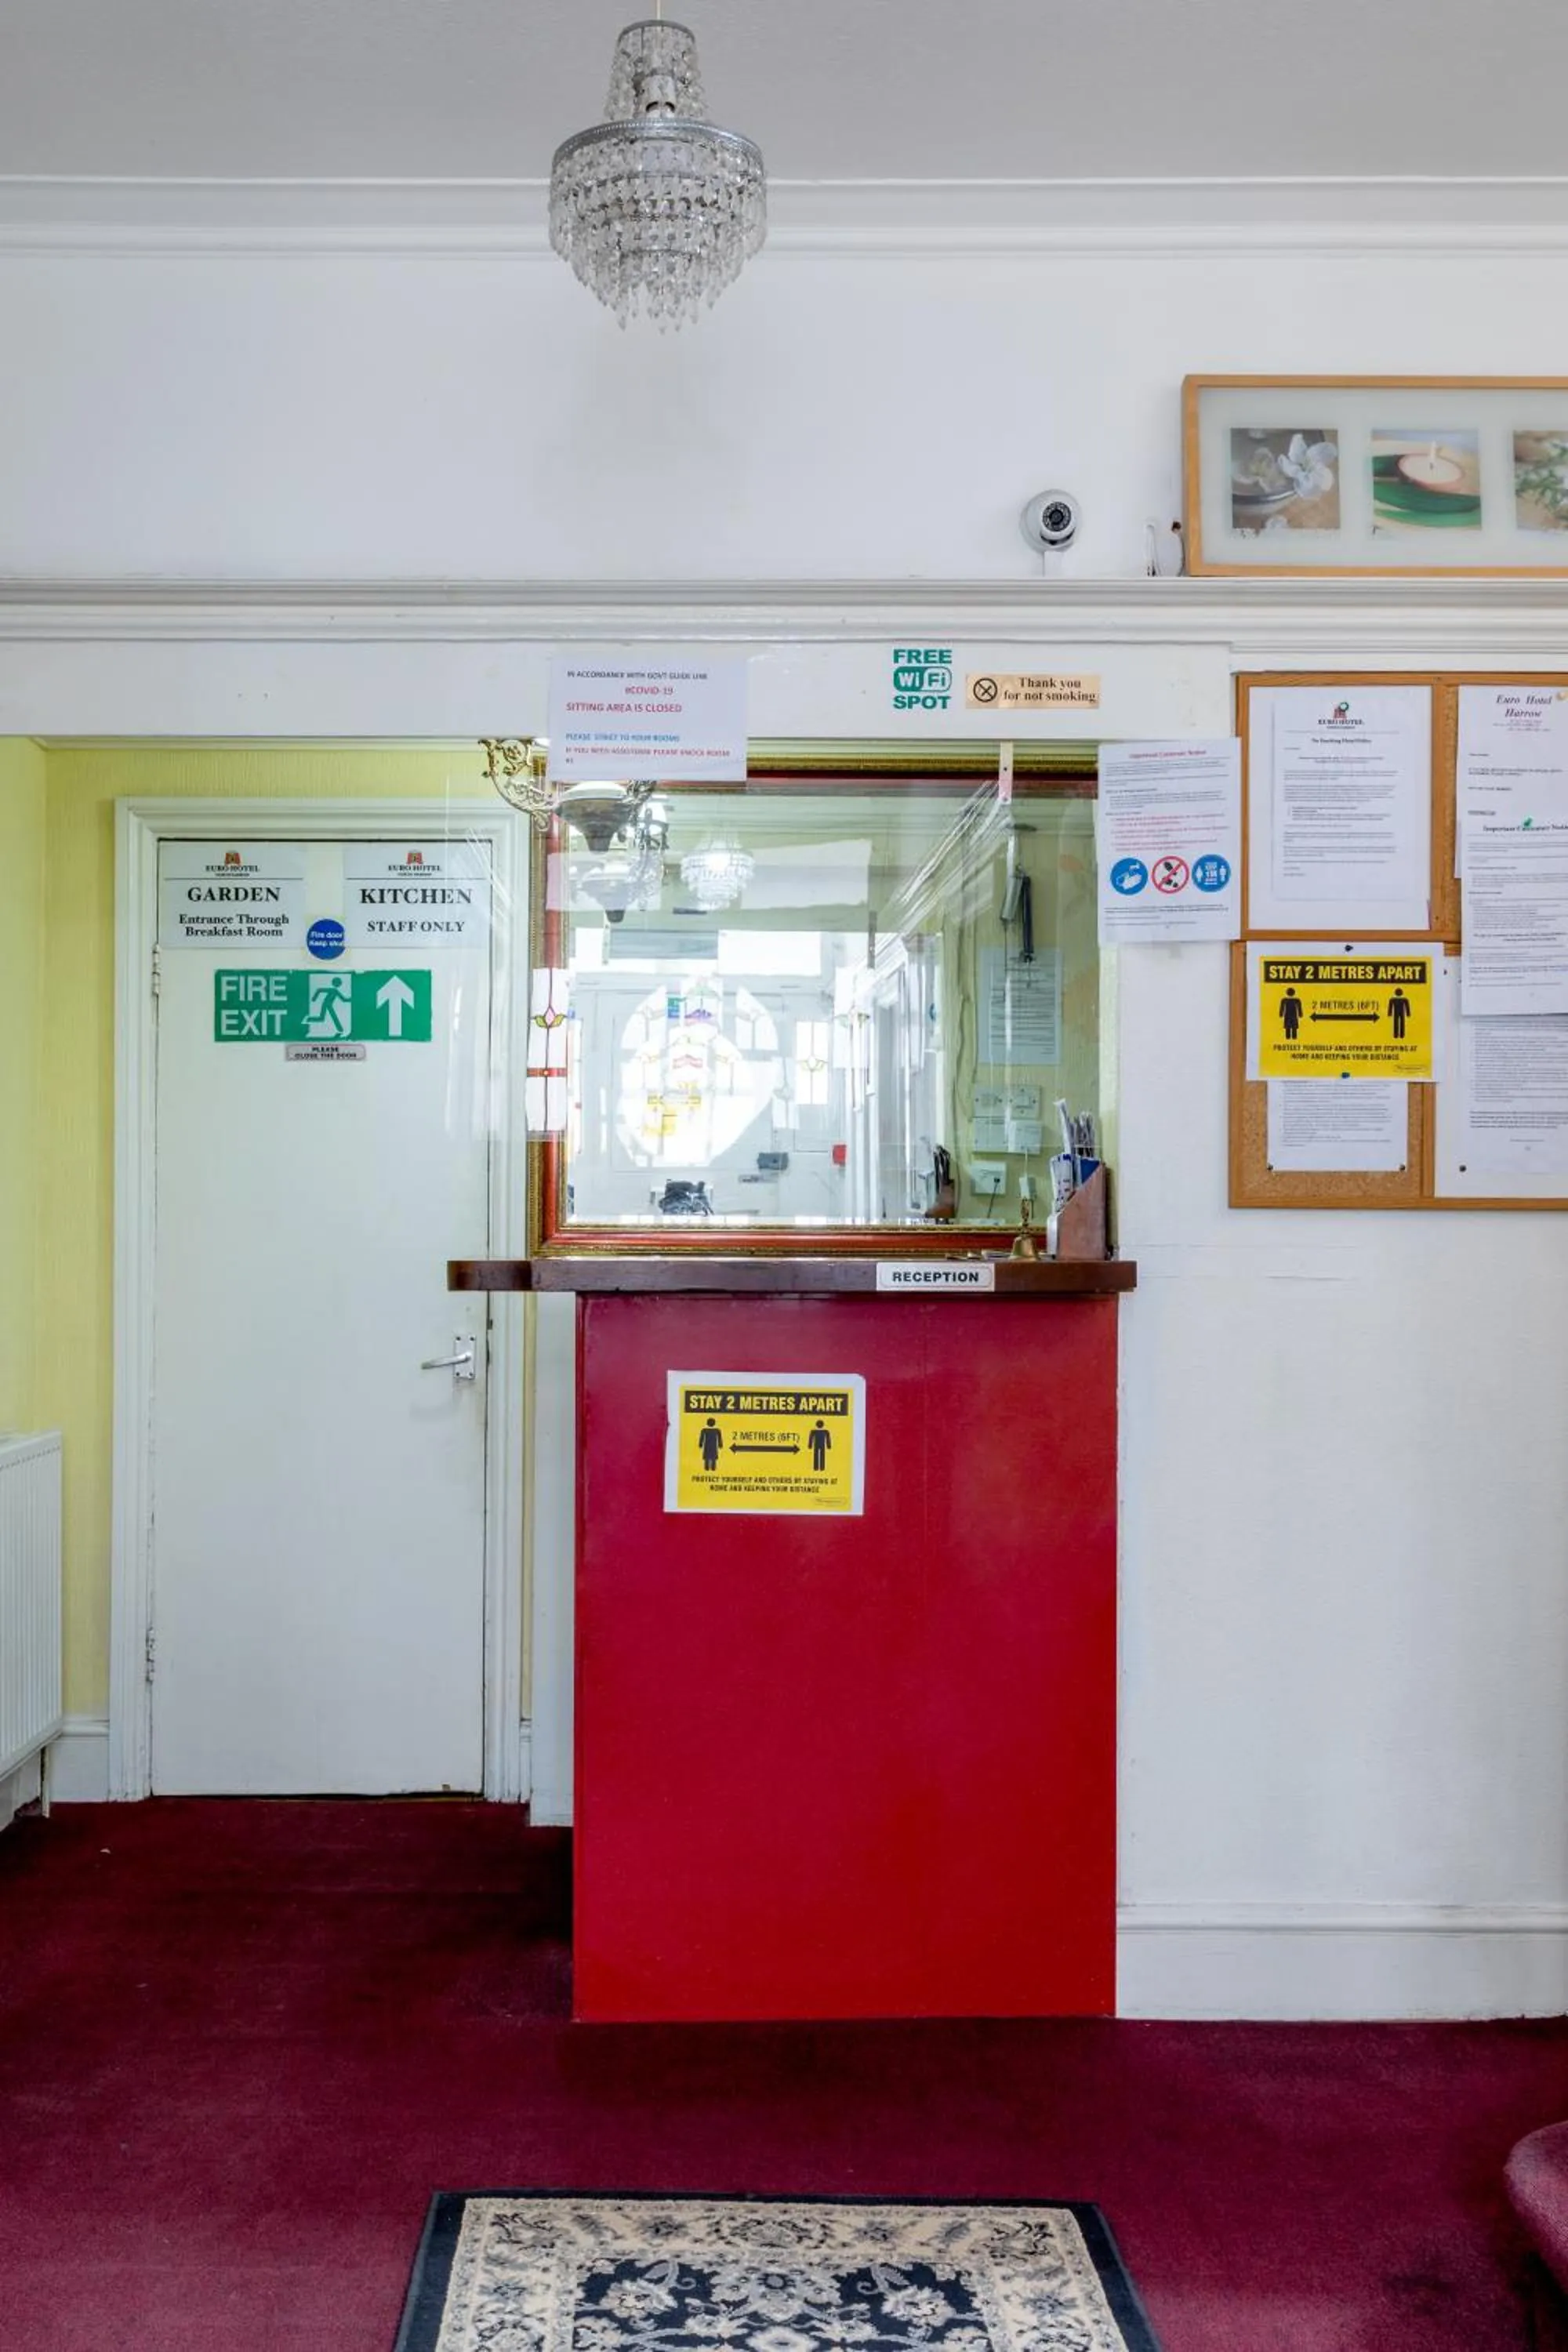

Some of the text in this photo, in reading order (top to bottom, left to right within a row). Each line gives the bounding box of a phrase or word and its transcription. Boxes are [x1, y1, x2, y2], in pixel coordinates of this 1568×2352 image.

[893, 648, 953, 664] FREE
[1018, 677, 1081, 691] Thank you
[893, 695, 952, 710] SPOT
[1004, 690, 1098, 703] for not smoking
[1496, 694, 1553, 705] Euro Hotel
[565, 702, 682, 713] SITTING AREA IS CLOSED
[1504, 708, 1543, 718] Harrow
[565, 733, 591, 742] PLEASE
[187, 886, 281, 902] GARDEN
[360, 887, 473, 904] KITCHEN
[179, 913, 289, 927] Entrance Through
[367, 920, 465, 932] STAFF ONLY
[185, 926, 283, 937] Breakfast Room
[1269, 964, 1422, 980] STAY 2 METRES APART
[220, 975, 288, 1001] FIRE
[1312, 1000, 1380, 1011] 2 METRES (6FT)
[220, 1008, 288, 1036] EXIT
[891, 1271, 980, 1283] RECEPTION
[688, 1394, 844, 1412] STAY 2 METRES APART
[731, 1431, 800, 1443] 2 METRES (6FT)
[721, 1475, 753, 1484] YOURSELF
